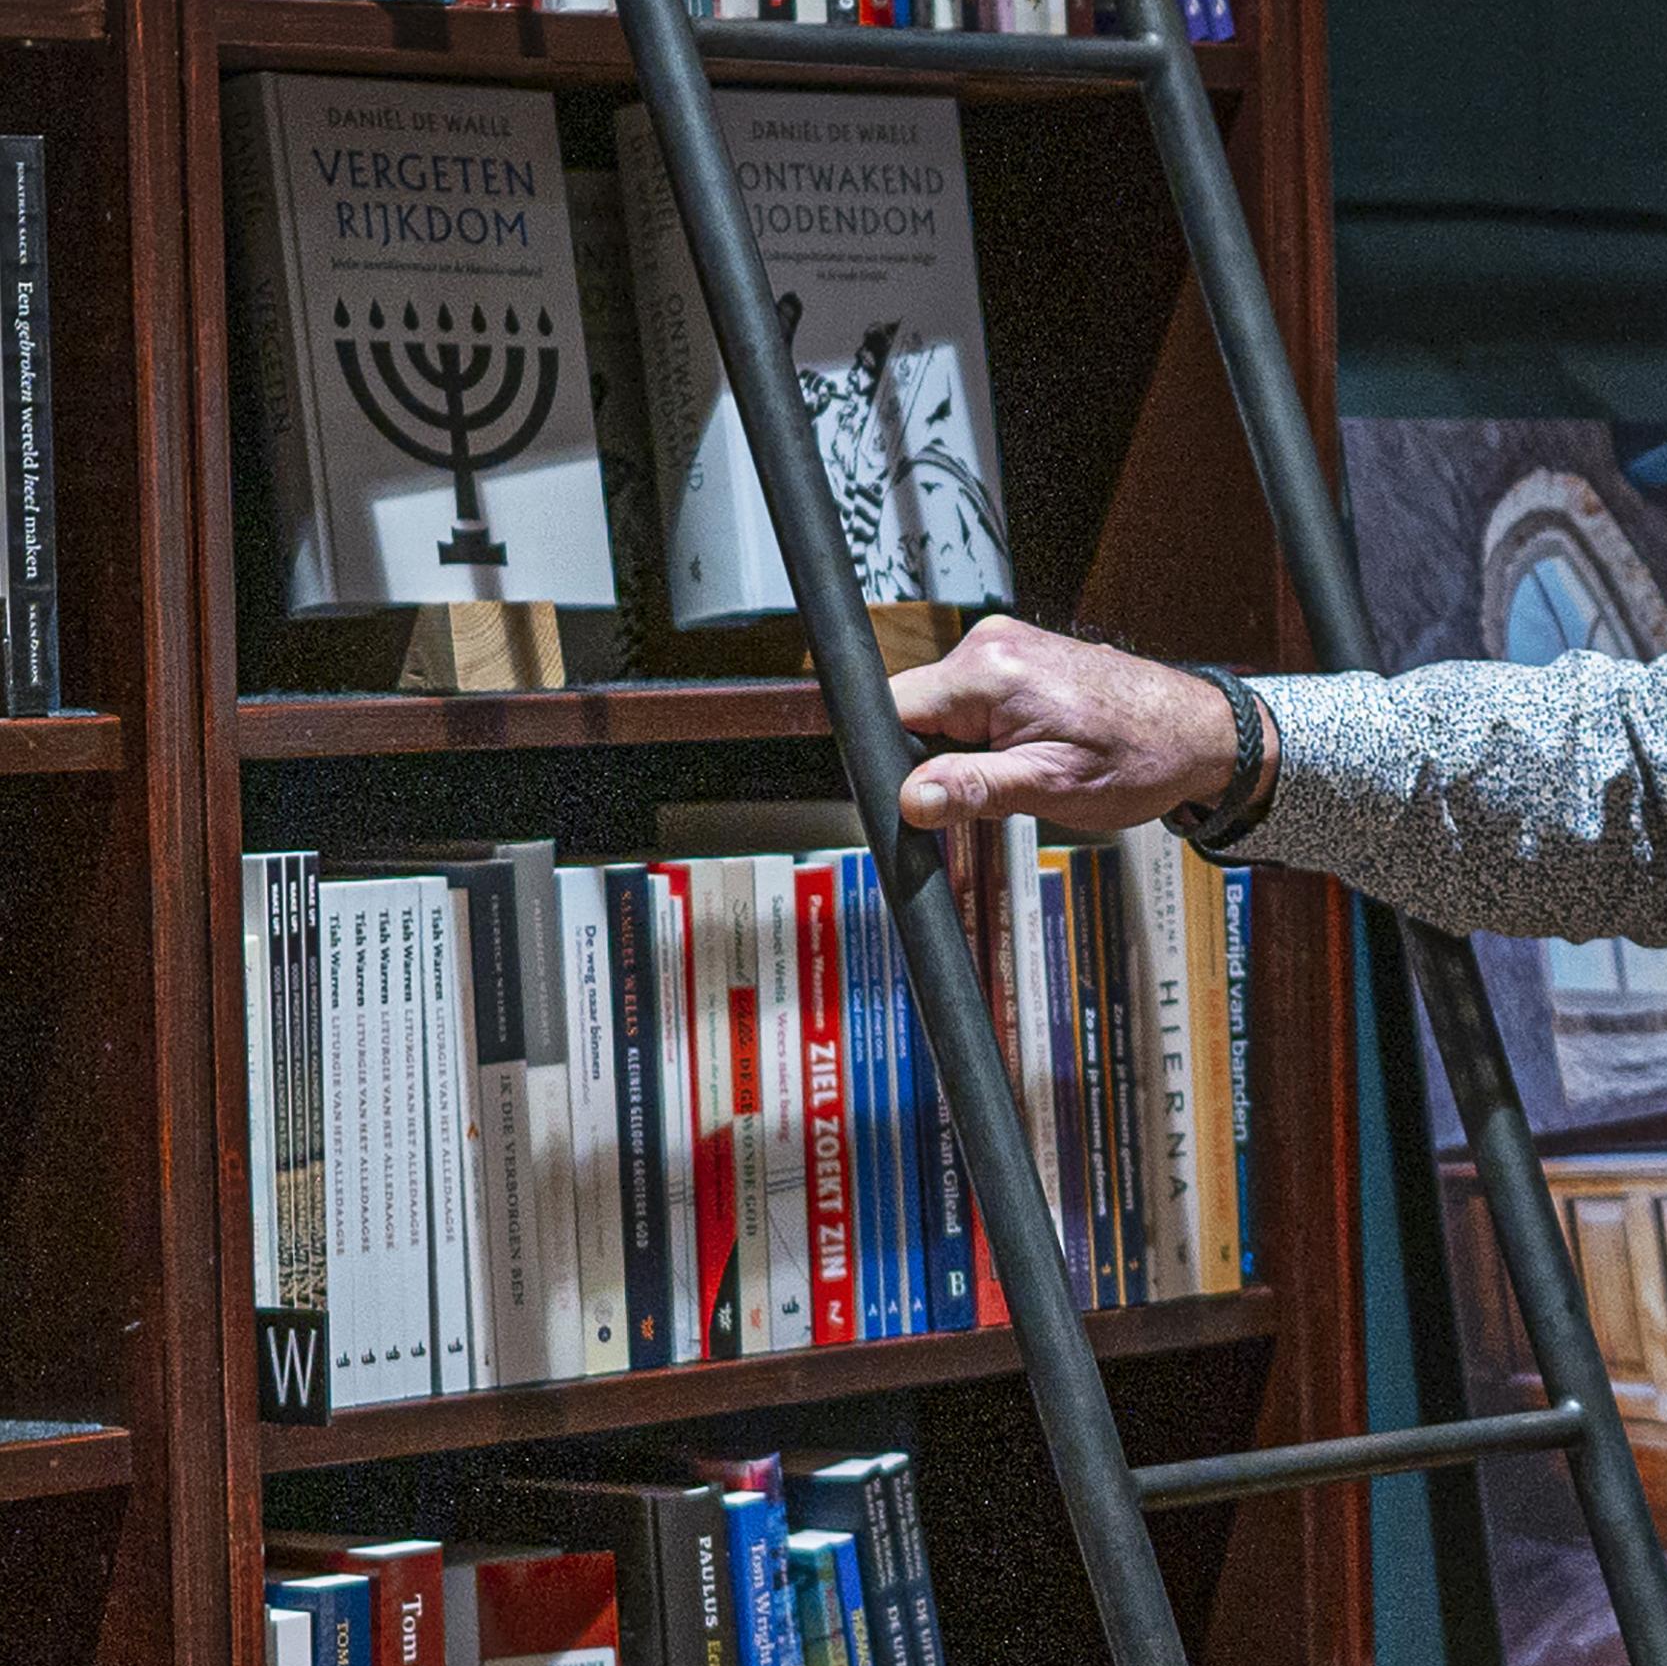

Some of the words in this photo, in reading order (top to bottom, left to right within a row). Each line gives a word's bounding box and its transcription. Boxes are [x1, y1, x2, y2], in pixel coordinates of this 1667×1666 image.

[329, 110, 405, 132] DANIEL
[412, 113, 433, 134] DE
[312, 148, 536, 197] VERGETEN
[739, 161, 945, 195] ONTWAKEND
[335, 200, 528, 248] RIJKDOM
[755, 204, 936, 238] JODENDOM
[17, 281, 33, 317] Een
[13, 320, 39, 402] gebroken
[20, 405, 40, 471] wereld
[23, 473, 40, 514] heel
[25, 516, 43, 579] maken
[378, 910, 390, 942] Tish
[584, 925, 598, 947] De
[1225, 883, 1246, 978] Bevrijd
[379, 946, 391, 1004] Warren
[581, 953, 598, 984] weg
[587, 988, 599, 1022] naar
[1229, 982, 1245, 1033] van
[588, 1024, 602, 1080] binnen
[808, 1040, 839, 1109] ZIEL
[499, 1073, 514, 1097] IK
[1159, 980, 1189, 1201] HIERNA
[1230, 1039, 1249, 1141] banden
[500, 1101, 516, 1134] DIE
[813, 1115, 842, 1214] ZOEKT
[939, 1127, 955, 1165] van
[503, 1141, 522, 1261] VERBORGEN
[943, 1170, 961, 1233] Gilead
[818, 1222, 848, 1283] ZIN
[511, 1268, 525, 1307] BEN
[265, 1329, 317, 1406] W
[698, 1535, 720, 1629] PAULUS
[337, 1618, 350, 1666] TOM
[401, 1594, 422, 1664] Tom
